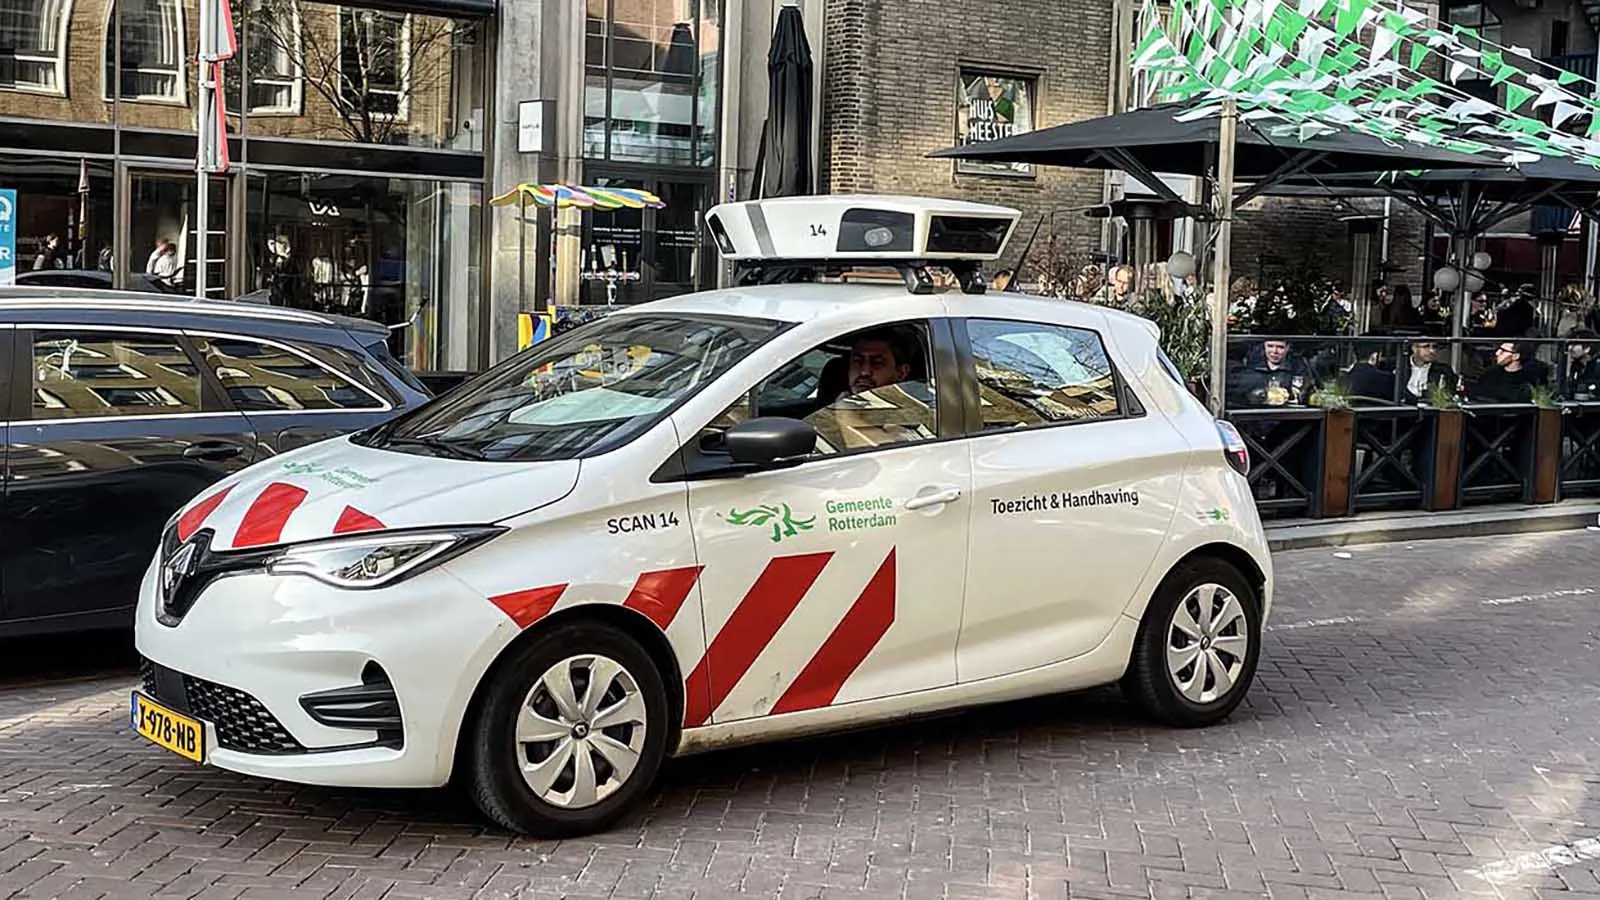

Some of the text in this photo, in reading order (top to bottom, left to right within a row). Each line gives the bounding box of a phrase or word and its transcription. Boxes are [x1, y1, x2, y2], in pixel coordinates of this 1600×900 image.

[970, 99, 994, 121] HUIS
[810, 223, 827, 237] 14
[826, 496, 893, 514] Gemeente
[991, 488, 1139, 514] Toezicht & Handhaving
[607, 511, 679, 534] SCAN 14
[828, 513, 897, 532] Rotterdam
[139, 703, 196, 753] X-978-NB
